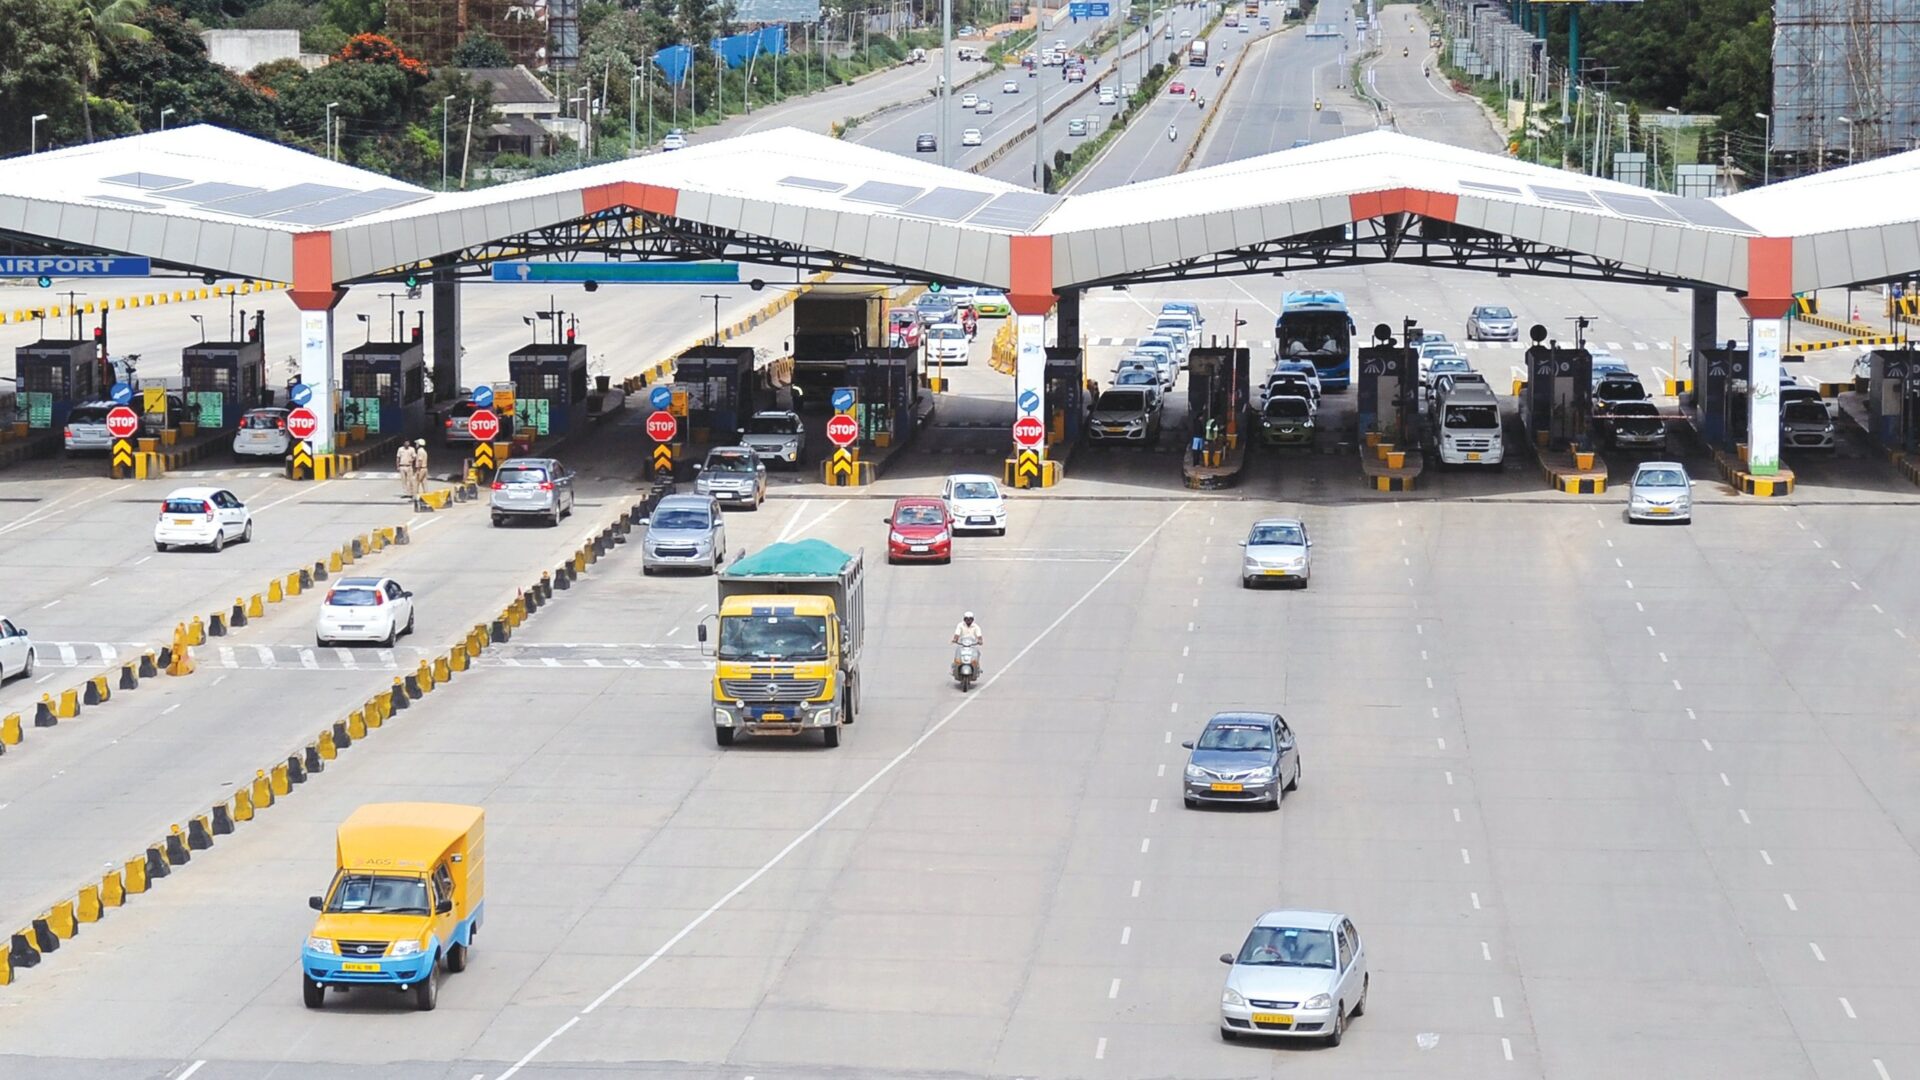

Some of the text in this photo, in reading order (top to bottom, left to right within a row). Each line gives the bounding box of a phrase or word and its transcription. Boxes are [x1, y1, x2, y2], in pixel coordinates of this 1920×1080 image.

[109, 417, 135, 427] STOP
[289, 418, 315, 428] STOP
[471, 420, 496, 430] STOP
[649, 421, 674, 431] STOP
[830, 424, 856, 434] STOP
[1016, 426, 1042, 436] STOP
